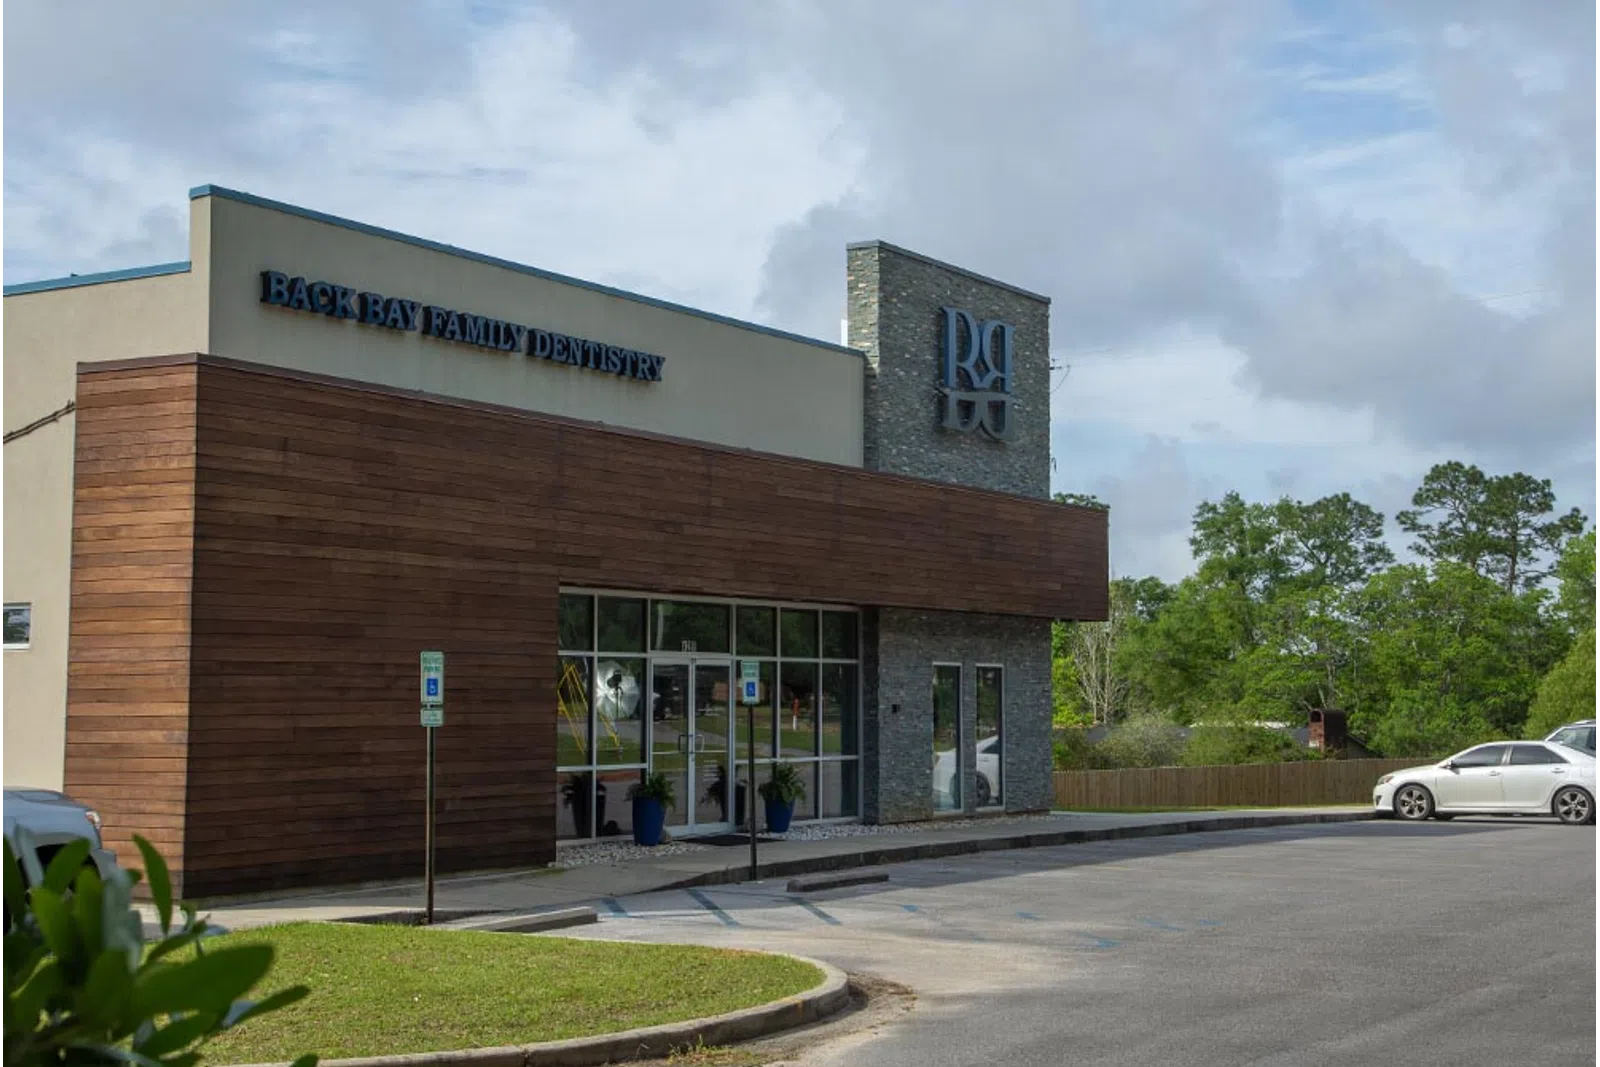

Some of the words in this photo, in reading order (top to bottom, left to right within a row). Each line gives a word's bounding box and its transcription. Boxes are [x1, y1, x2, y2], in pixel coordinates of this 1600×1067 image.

[261, 270, 358, 319] BACK
[358, 291, 422, 331] BAY
[423, 305, 527, 353] FAMILY
[527, 328, 666, 381] DENTISTRY
